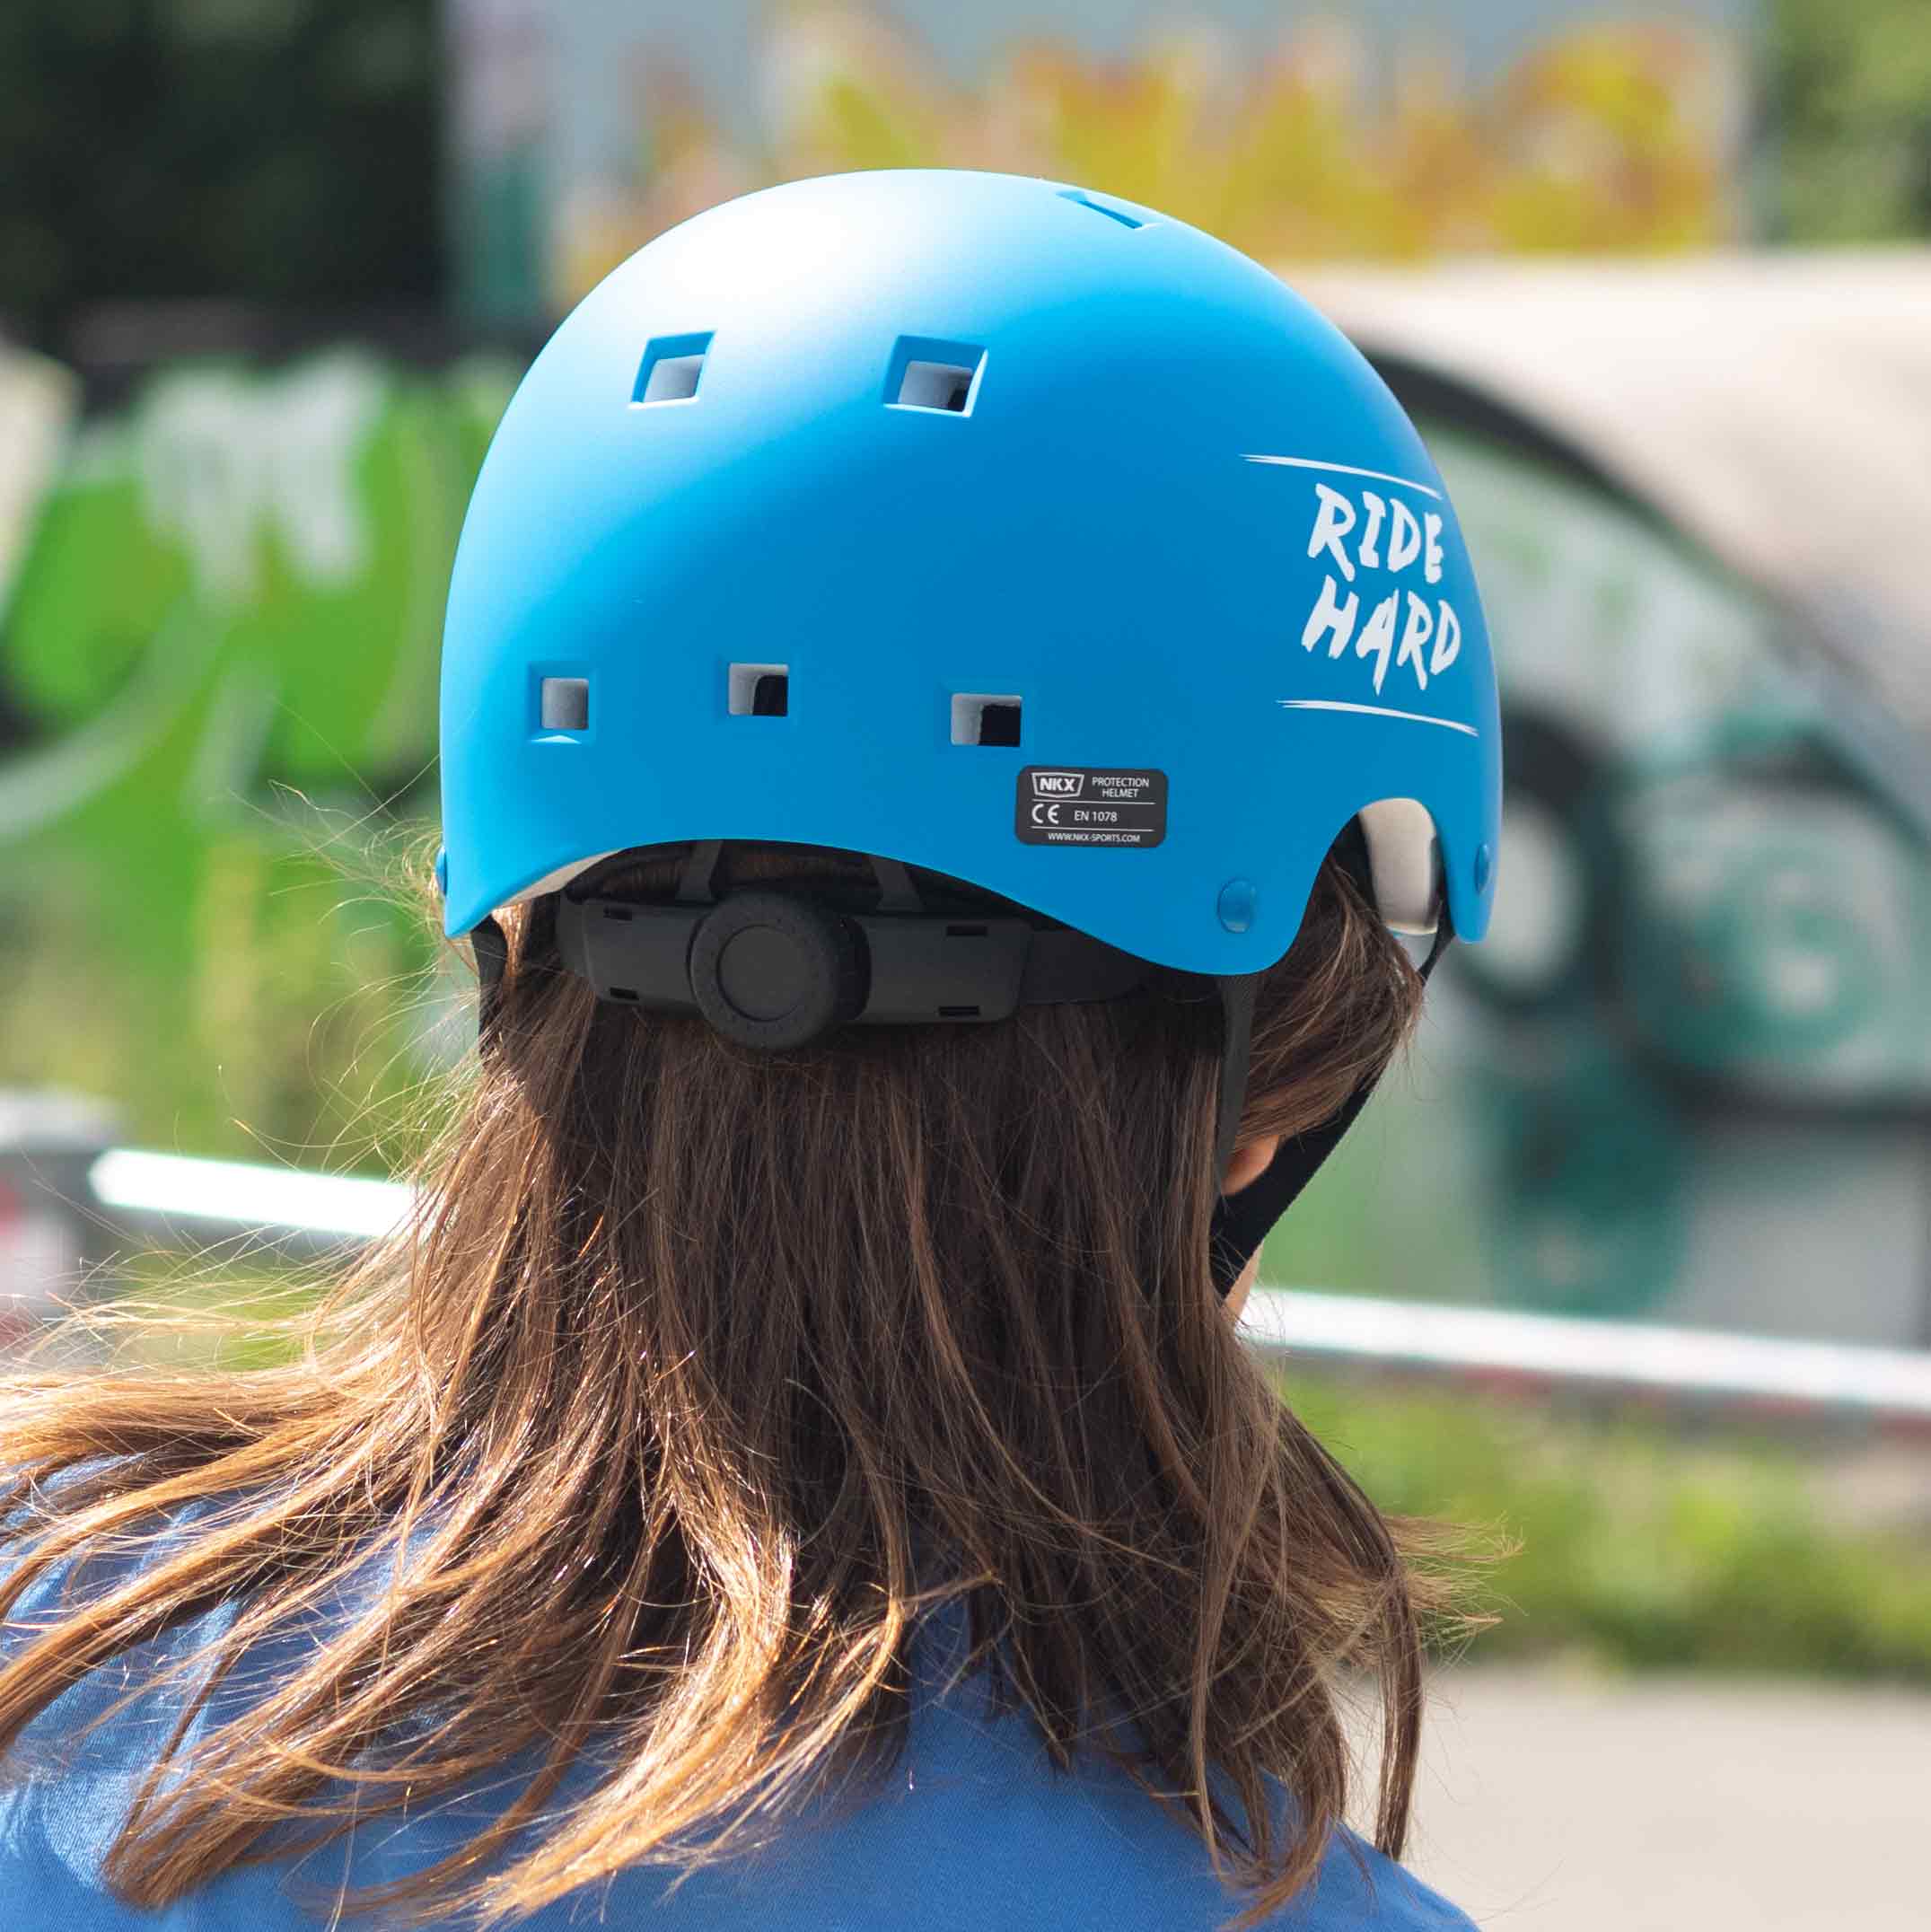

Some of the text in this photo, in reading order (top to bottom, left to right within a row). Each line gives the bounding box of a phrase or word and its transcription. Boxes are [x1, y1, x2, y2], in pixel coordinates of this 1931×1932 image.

[1307, 482, 1444, 584] RIDE
[1301, 574, 1461, 696] HARD
[1040, 777, 1075, 792] NKX
[1092, 777, 1150, 787] PROTECTION
[1102, 788, 1139, 798] HELMET
[1031, 804, 1060, 824] CE
[1074, 810, 1118, 822] EN 1078
[1048, 832, 1141, 842] WWW.NKX-SPORTS.COM
